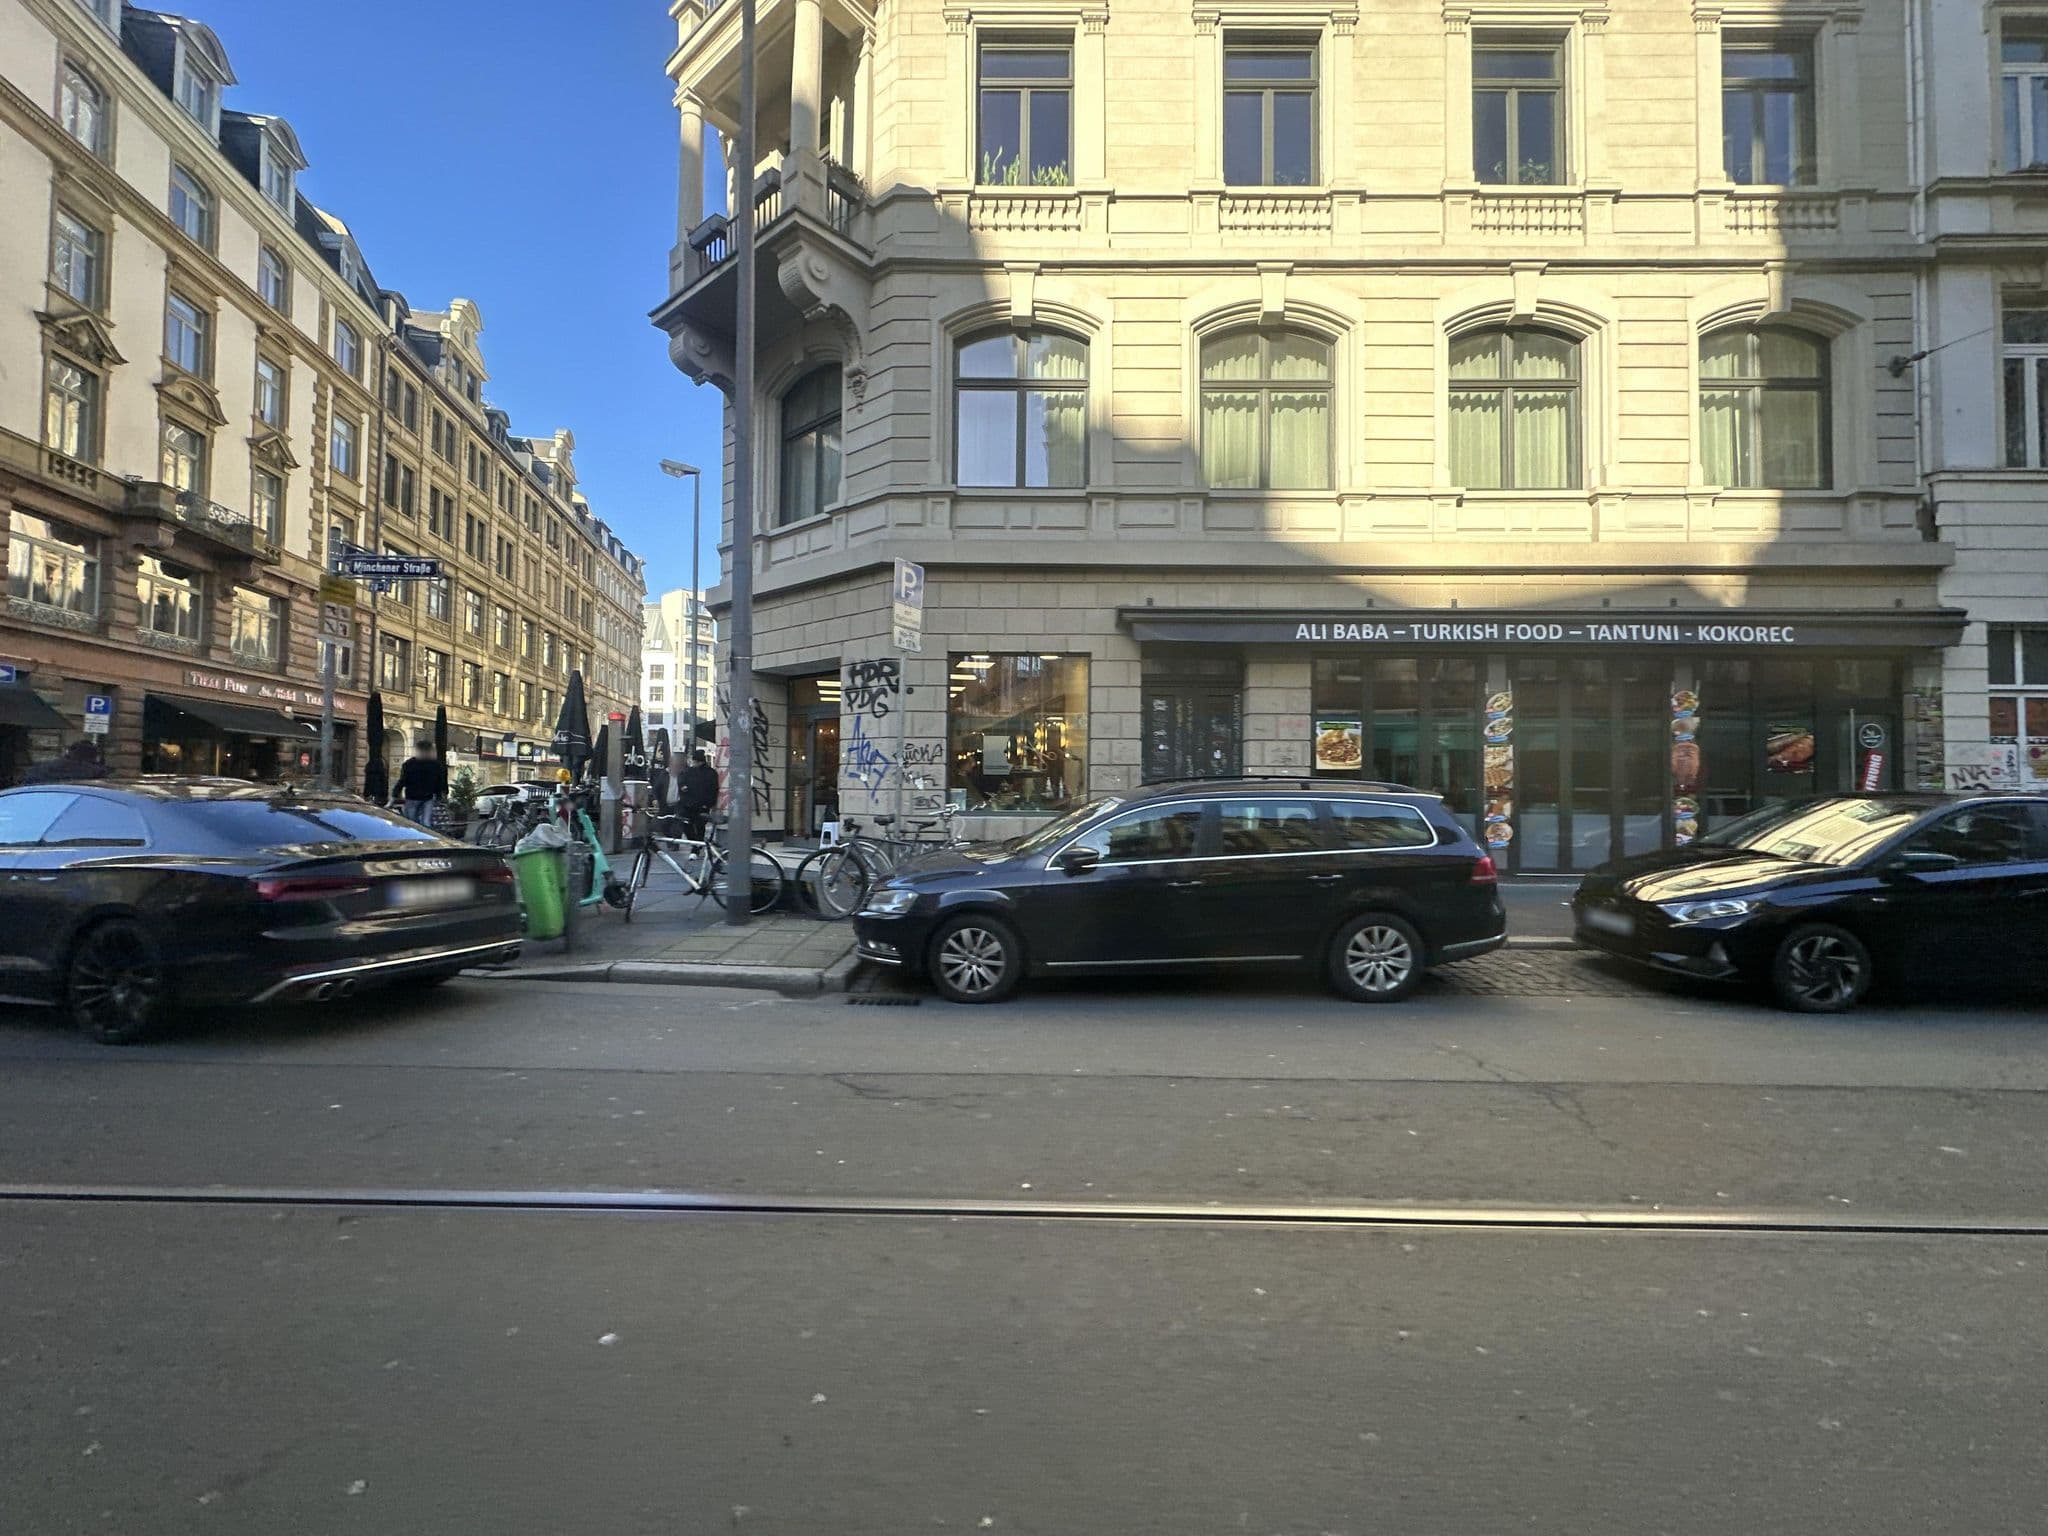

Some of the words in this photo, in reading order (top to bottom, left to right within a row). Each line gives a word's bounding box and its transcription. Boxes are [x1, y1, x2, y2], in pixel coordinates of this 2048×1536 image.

[403, 562, 431, 575] Straße
[1296, 623, 1327, 640] ALI
[1333, 623, 1389, 640] BABA
[1410, 623, 1499, 640] TURKISH
[1505, 624, 1563, 640] FOOD
[1586, 624, 1679, 641] TANTUNI
[1698, 625, 1795, 643] KOKOREC
